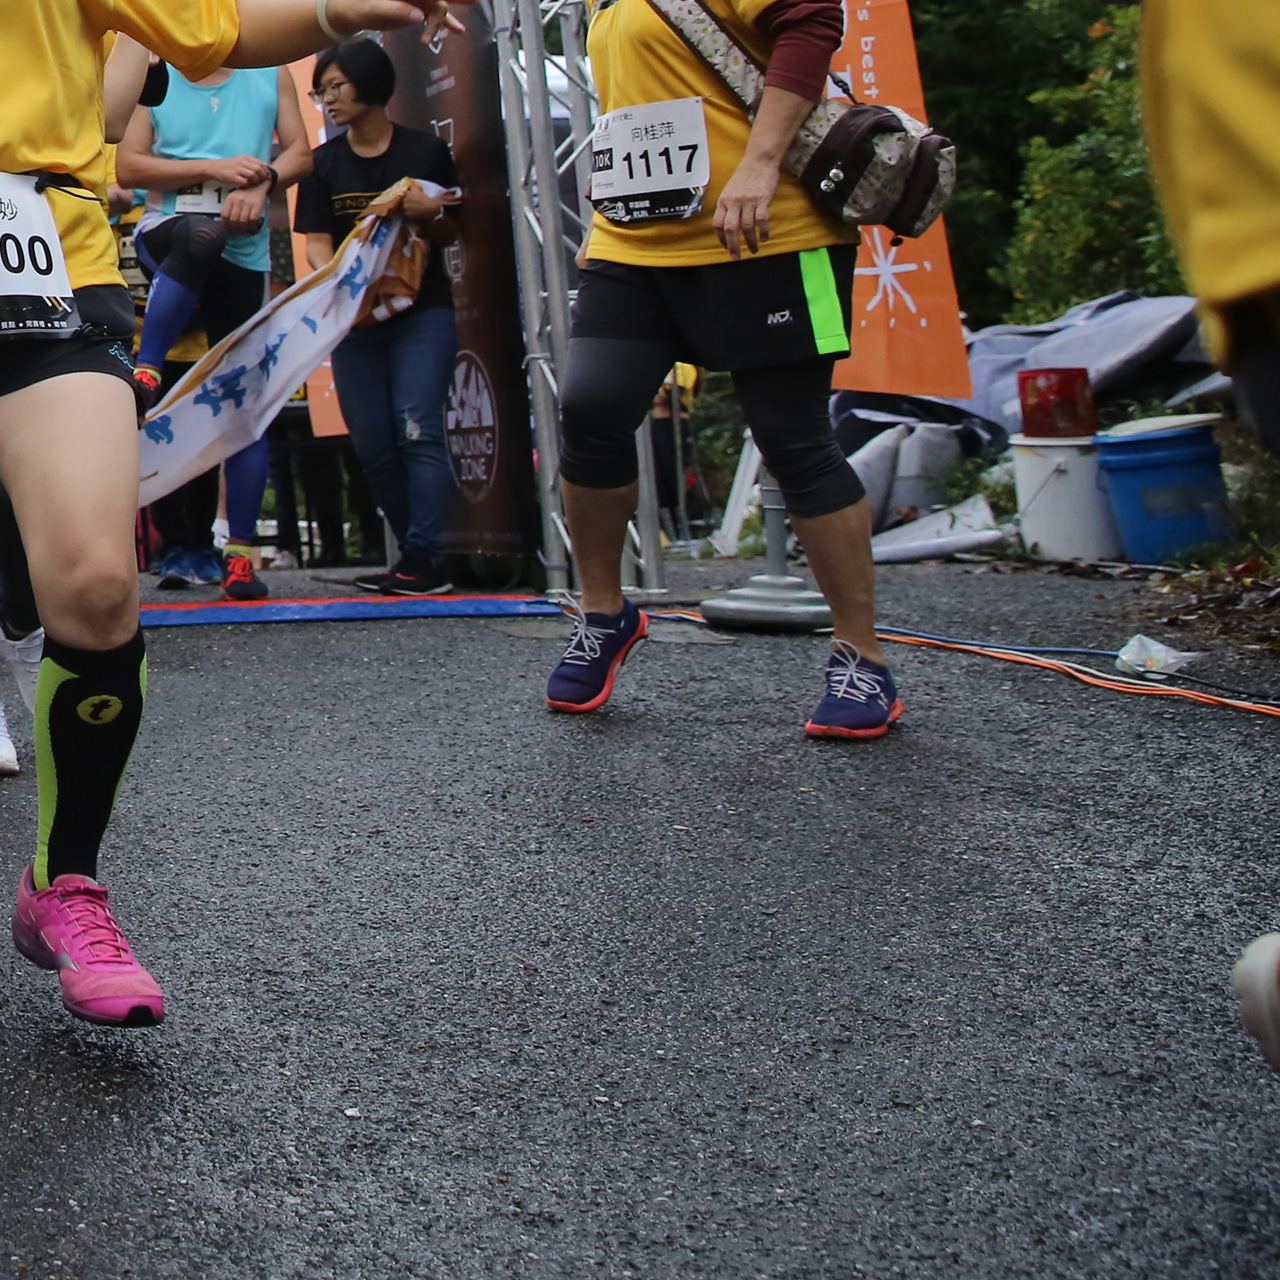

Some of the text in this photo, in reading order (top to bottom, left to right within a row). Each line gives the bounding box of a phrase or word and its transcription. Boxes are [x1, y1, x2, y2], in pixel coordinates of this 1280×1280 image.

[860, 36, 880, 99] best
[631, 121, 675, 142] 向桂萍
[595, 152, 611, 168] 10K
[622, 144, 698, 179] 1117
[449, 431, 493, 457] WALKING
[460, 457, 487, 481] ZONE
